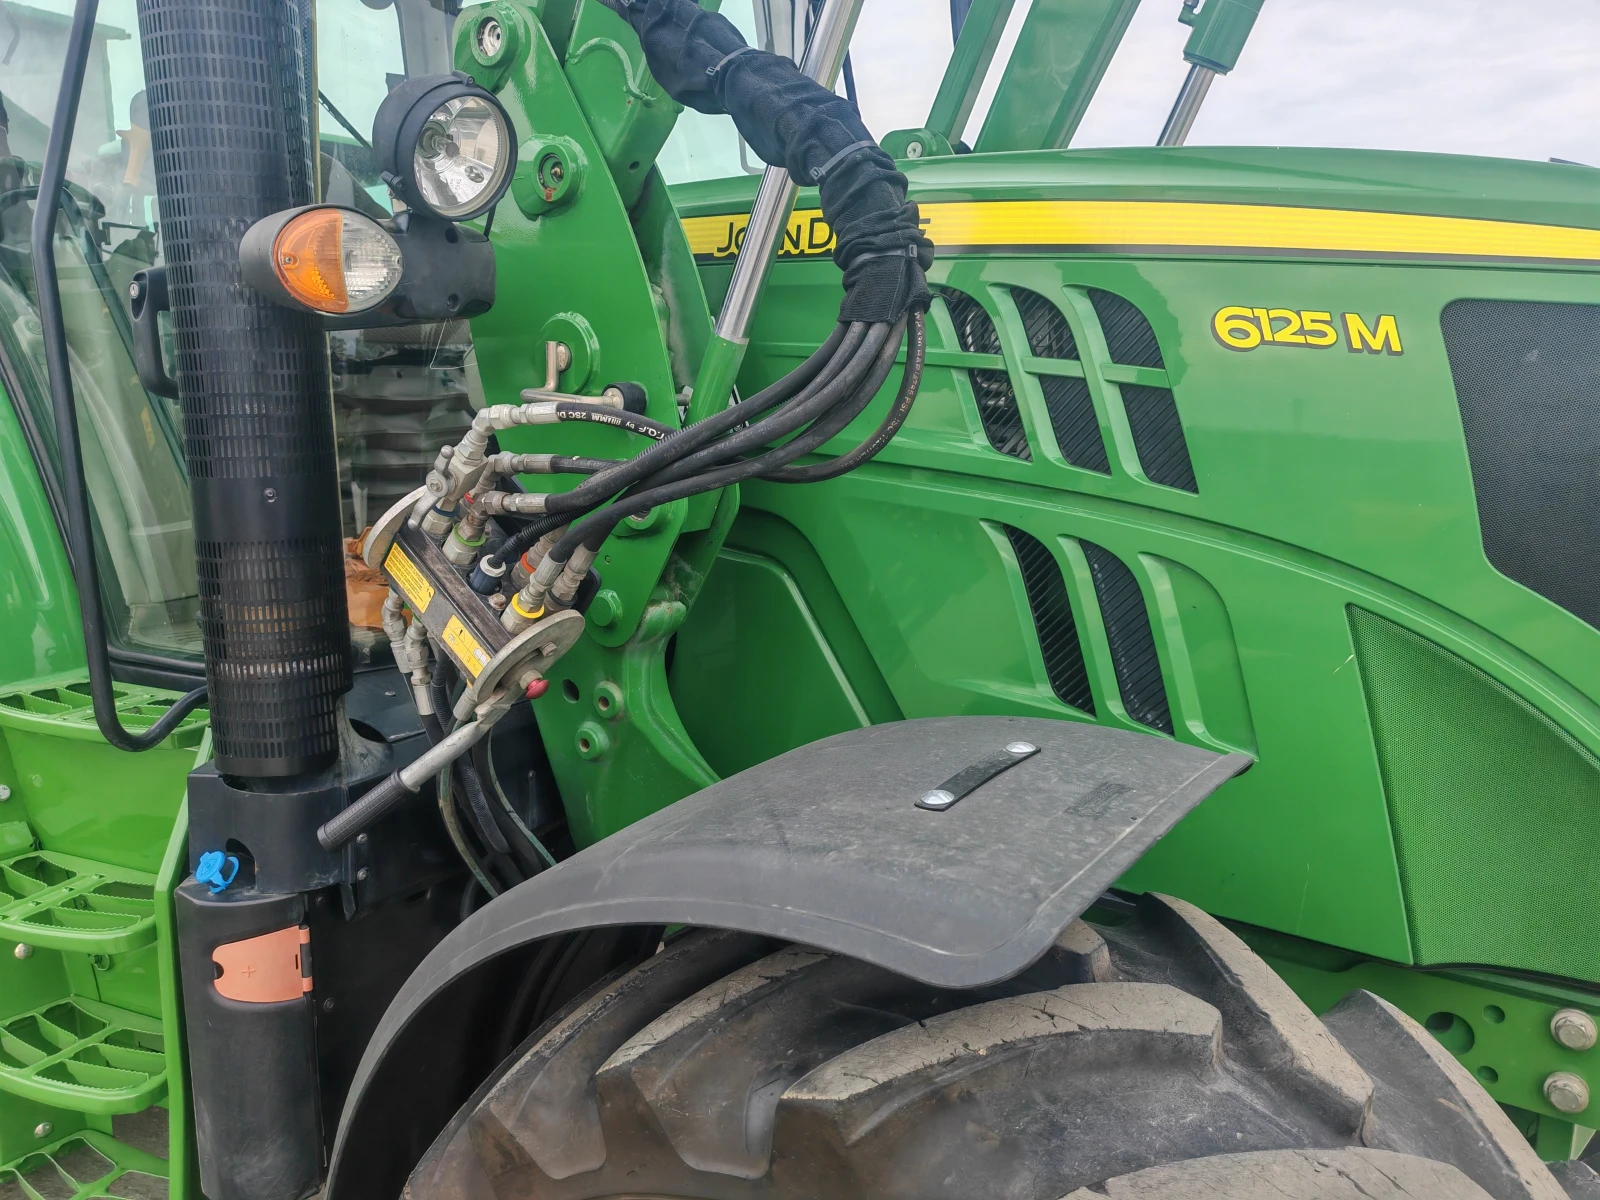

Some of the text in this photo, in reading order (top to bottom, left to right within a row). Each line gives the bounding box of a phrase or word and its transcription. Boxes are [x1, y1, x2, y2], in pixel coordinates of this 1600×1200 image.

[1211, 305, 1404, 356] 6125 M
[568, 411, 587, 419] 2SC
[625, 421, 635, 429] by
